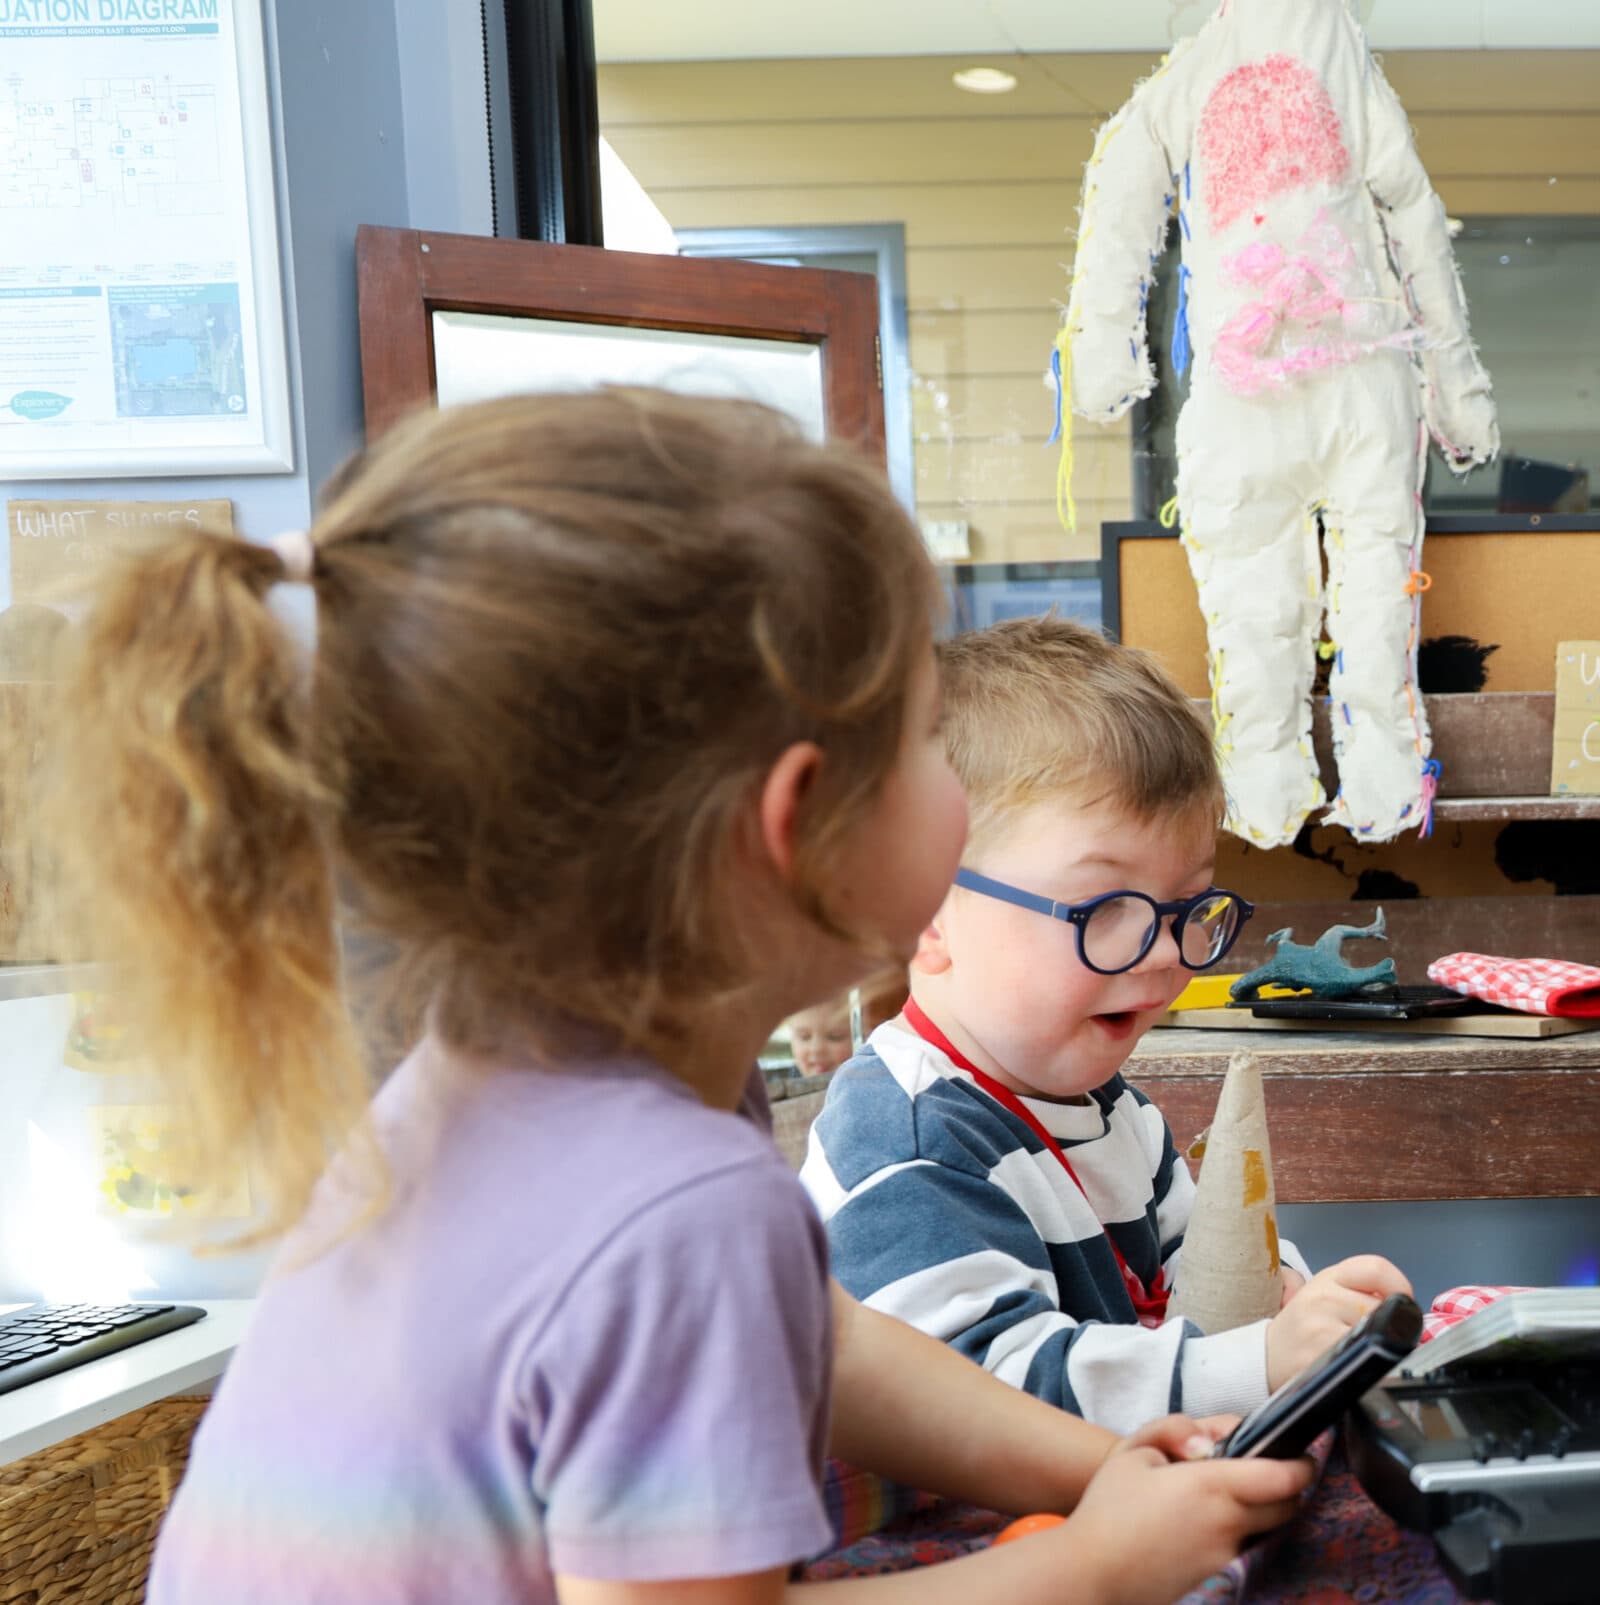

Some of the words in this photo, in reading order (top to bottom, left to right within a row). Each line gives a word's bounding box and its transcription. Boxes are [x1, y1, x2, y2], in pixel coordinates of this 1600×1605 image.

[100, 0, 217, 20] DIAGRAM
[162, 24, 187, 33] FLOOR
[16, 509, 96, 537] WHAT
